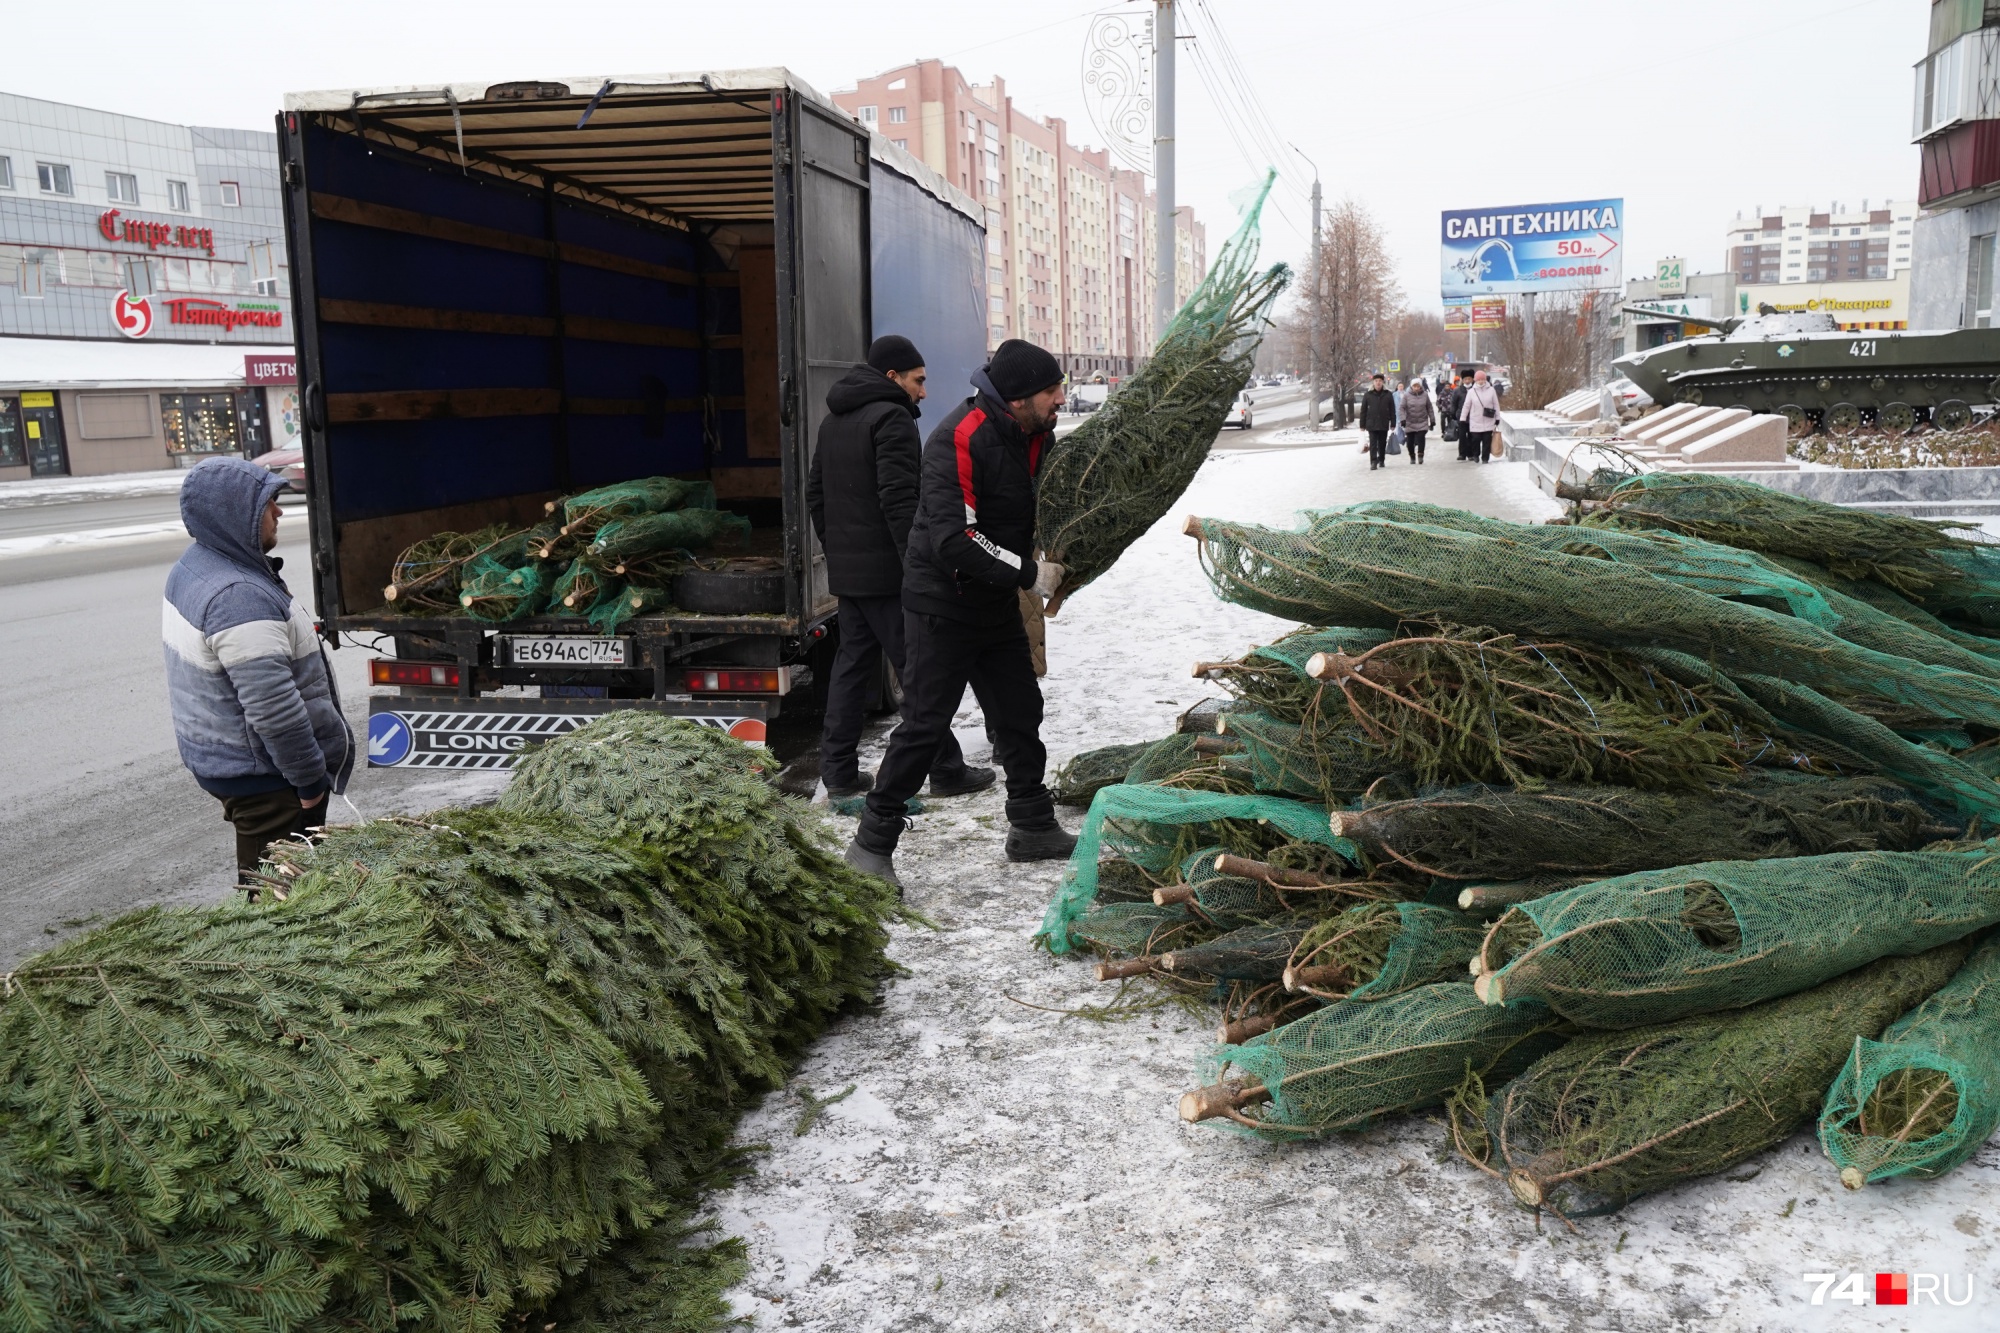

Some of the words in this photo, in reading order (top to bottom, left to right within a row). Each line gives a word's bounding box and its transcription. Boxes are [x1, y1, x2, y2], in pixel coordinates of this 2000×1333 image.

[1447, 207, 1618, 239] САНТЕХНИКА
[100, 208, 215, 257] Стрелец
[1558, 240, 1582, 255] 50
[1660, 264, 1681, 281] 24
[1820, 298, 1892, 312] Пекарня
[162, 298, 282, 331] Пятёрочка
[1850, 341, 1876, 356] 421
[253, 362, 297, 380] ЦВЕТЫ
[592, 641, 619, 655] 774
[429, 734, 525, 750] LONG
